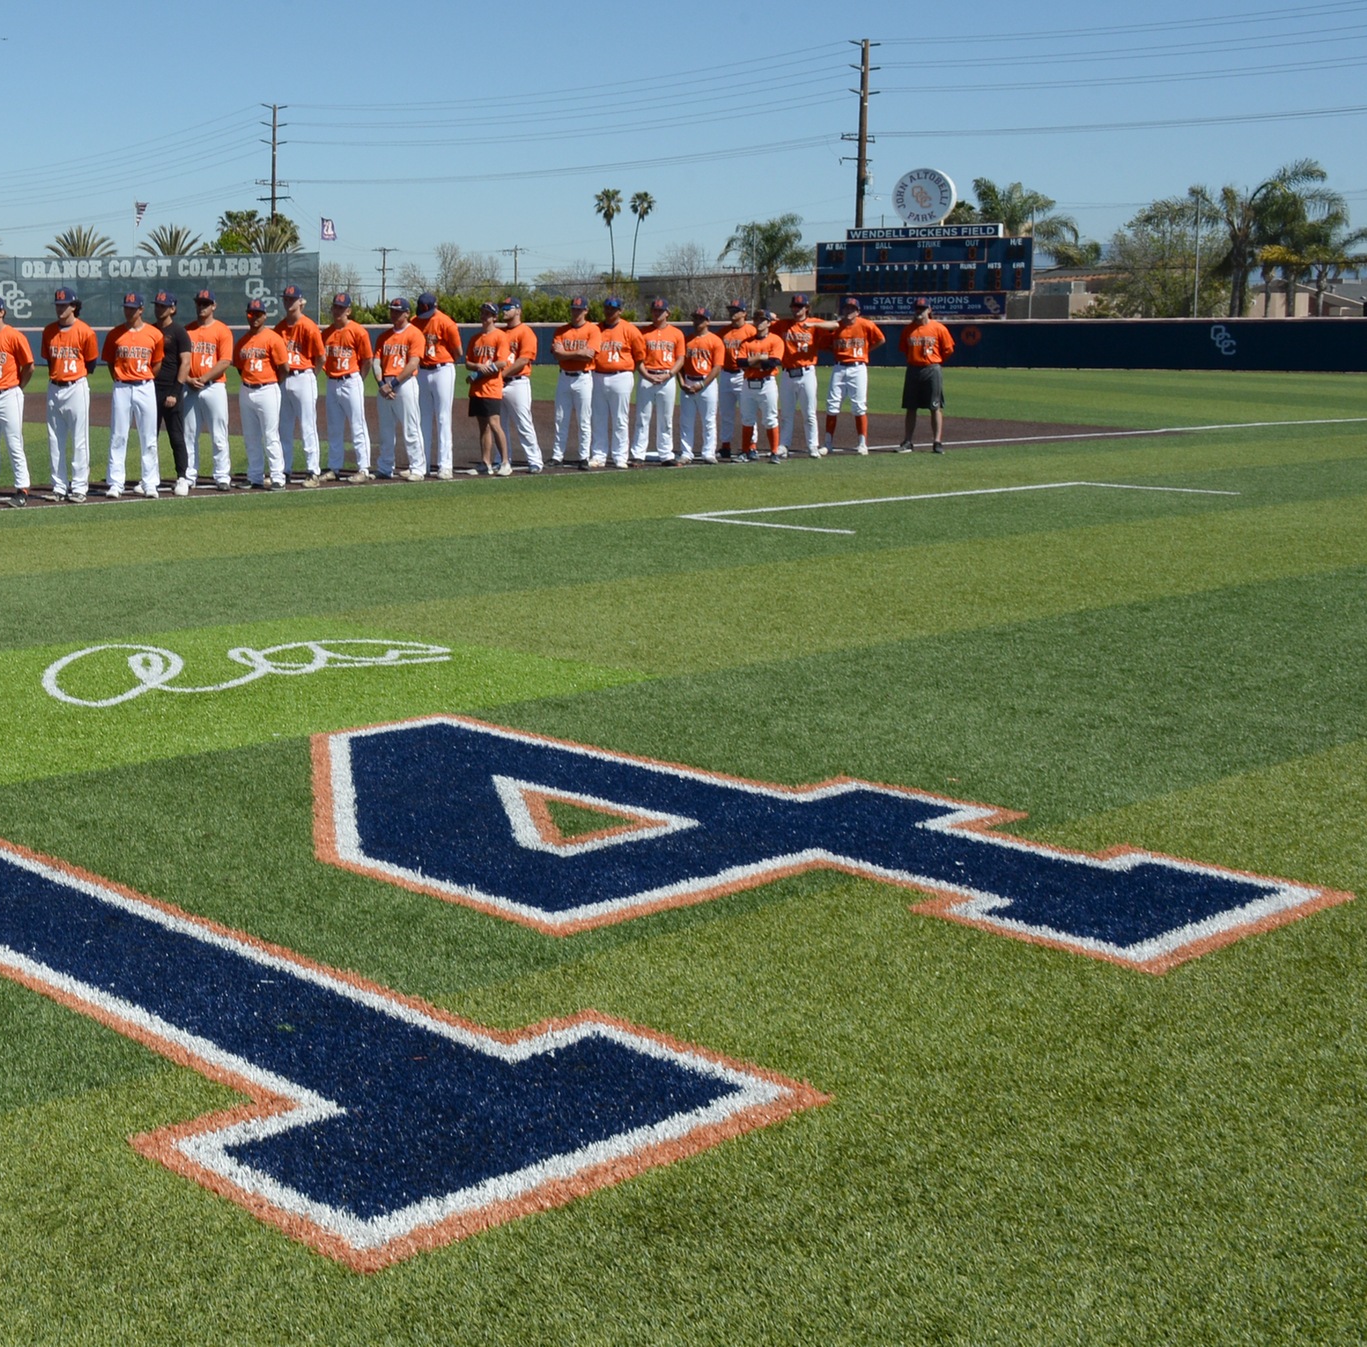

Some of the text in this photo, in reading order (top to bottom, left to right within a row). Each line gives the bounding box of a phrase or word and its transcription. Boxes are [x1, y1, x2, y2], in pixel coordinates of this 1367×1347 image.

[896, 171, 948, 209] JOHN ALTOBELLI
[907, 211, 936, 222] PARK
[849, 226, 995, 240] WENDELL PICKENS FIELD
[1010, 238, 1023, 246] H/E
[21, 257, 262, 278] ORANGE COAST COLLEGE
[0, 280, 32, 319] OCC
[873, 296, 969, 305] STATE CMPIONS
[1210, 325, 1236, 355] OCC
[287, 352, 301, 366] 14
[507, 353, 516, 365] 4
[606, 351, 619, 363] 14
[662, 351, 675, 363] 14
[852, 348, 863, 359] 14
[62, 359, 77, 374] 14
[135, 359, 149, 373] 14
[200, 354, 214, 369] 14
[248, 359, 263, 372] 14
[335, 357, 349, 371] 14
[392, 355, 405, 369] 14
[697, 358, 708, 371] 14
